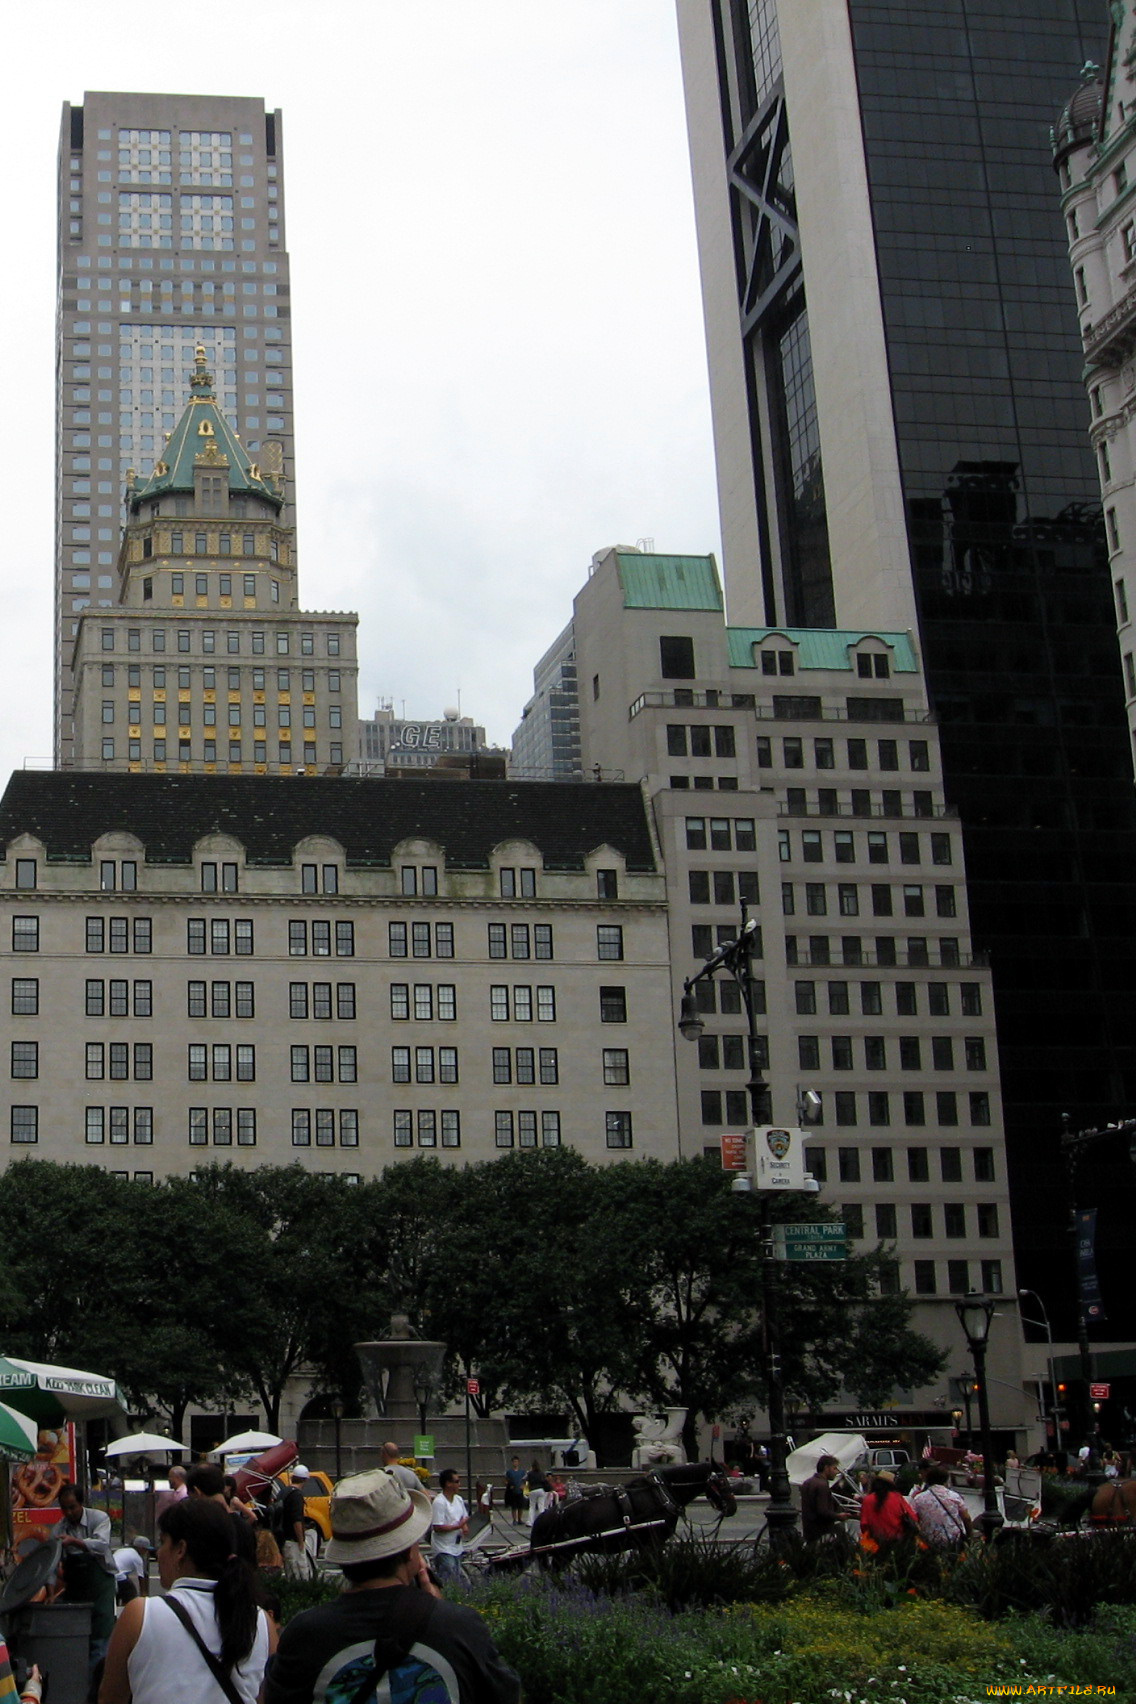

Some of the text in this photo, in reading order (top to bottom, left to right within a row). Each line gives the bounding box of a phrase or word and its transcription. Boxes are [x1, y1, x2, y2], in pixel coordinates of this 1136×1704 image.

[400, 725, 442, 747] GE
[769, 1161, 791, 1169] SECURITY
[785, 1226, 844, 1236] CENTRAL PARK
[794, 1244, 816, 1252] GRAND
[86, 1383, 111, 1396] CLEAN
[845, 1415, 899, 1427] SARAH'S
